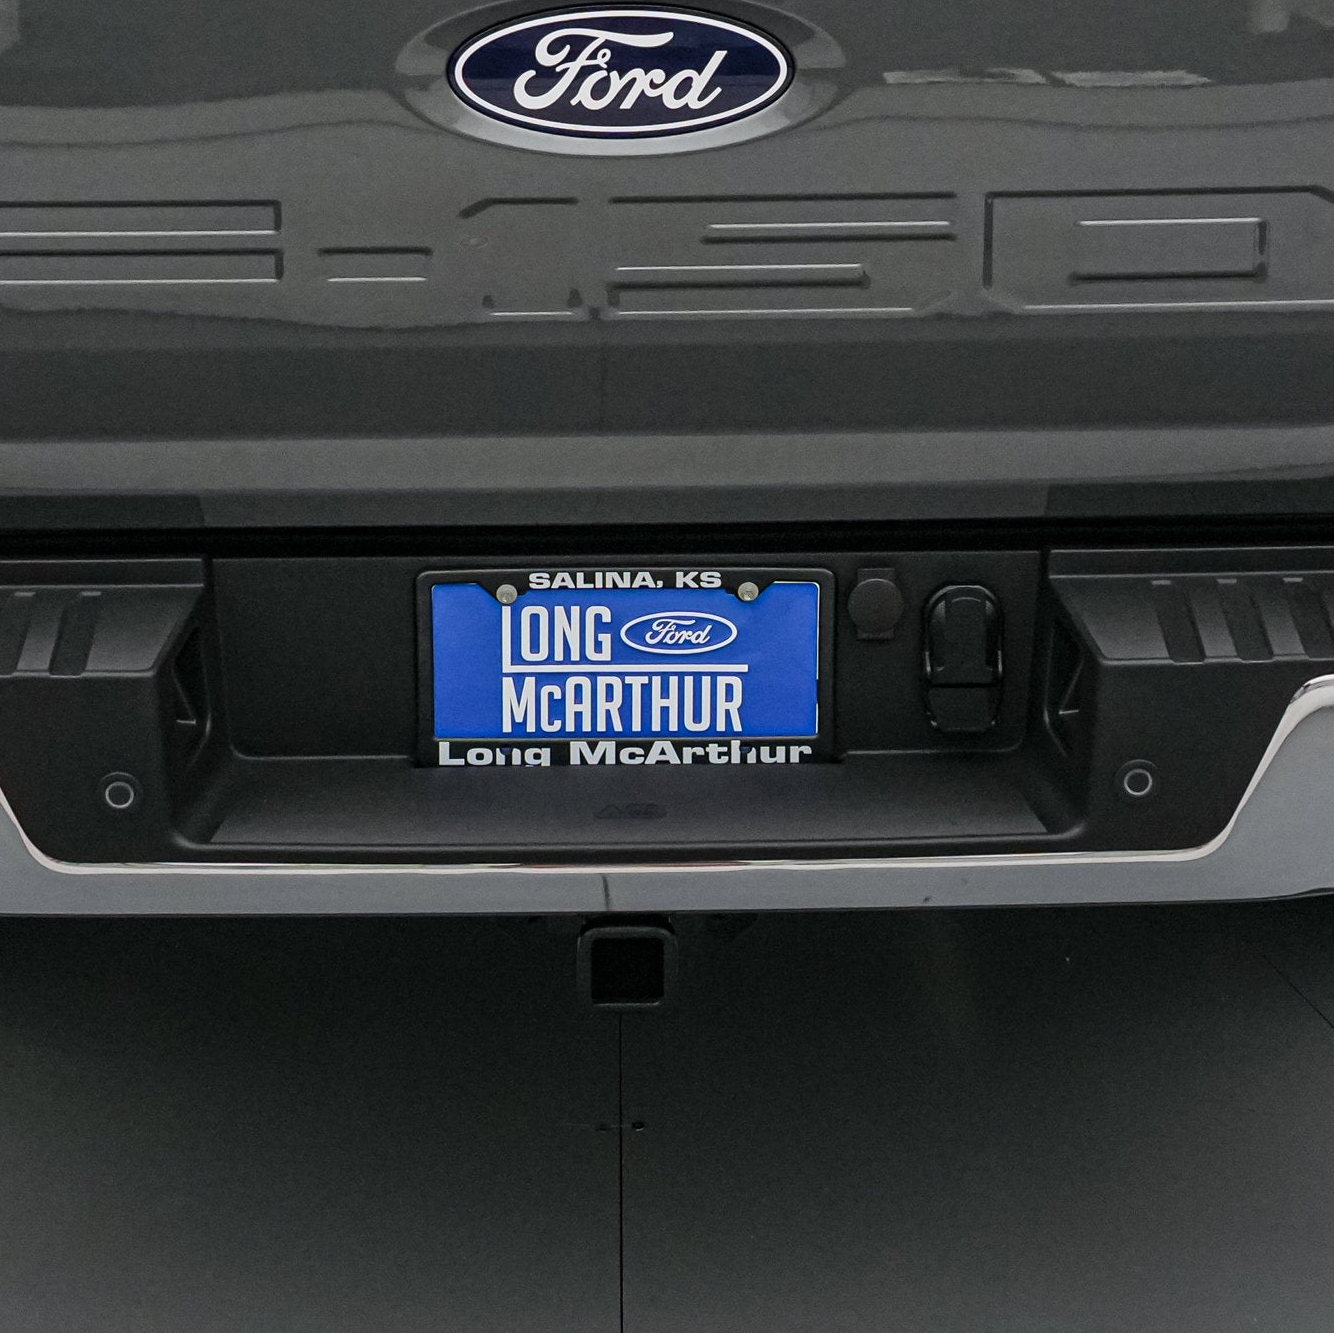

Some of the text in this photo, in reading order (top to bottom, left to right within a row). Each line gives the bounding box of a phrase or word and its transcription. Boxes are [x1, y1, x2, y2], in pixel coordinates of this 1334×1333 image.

[513, 27, 728, 111] Ford
[528, 571, 723, 590] SALINA, KS
[501, 604, 713, 671] LONG Ford
[501, 675, 743, 733] McARTHUR
[438, 739, 813, 767] Long McArthur
